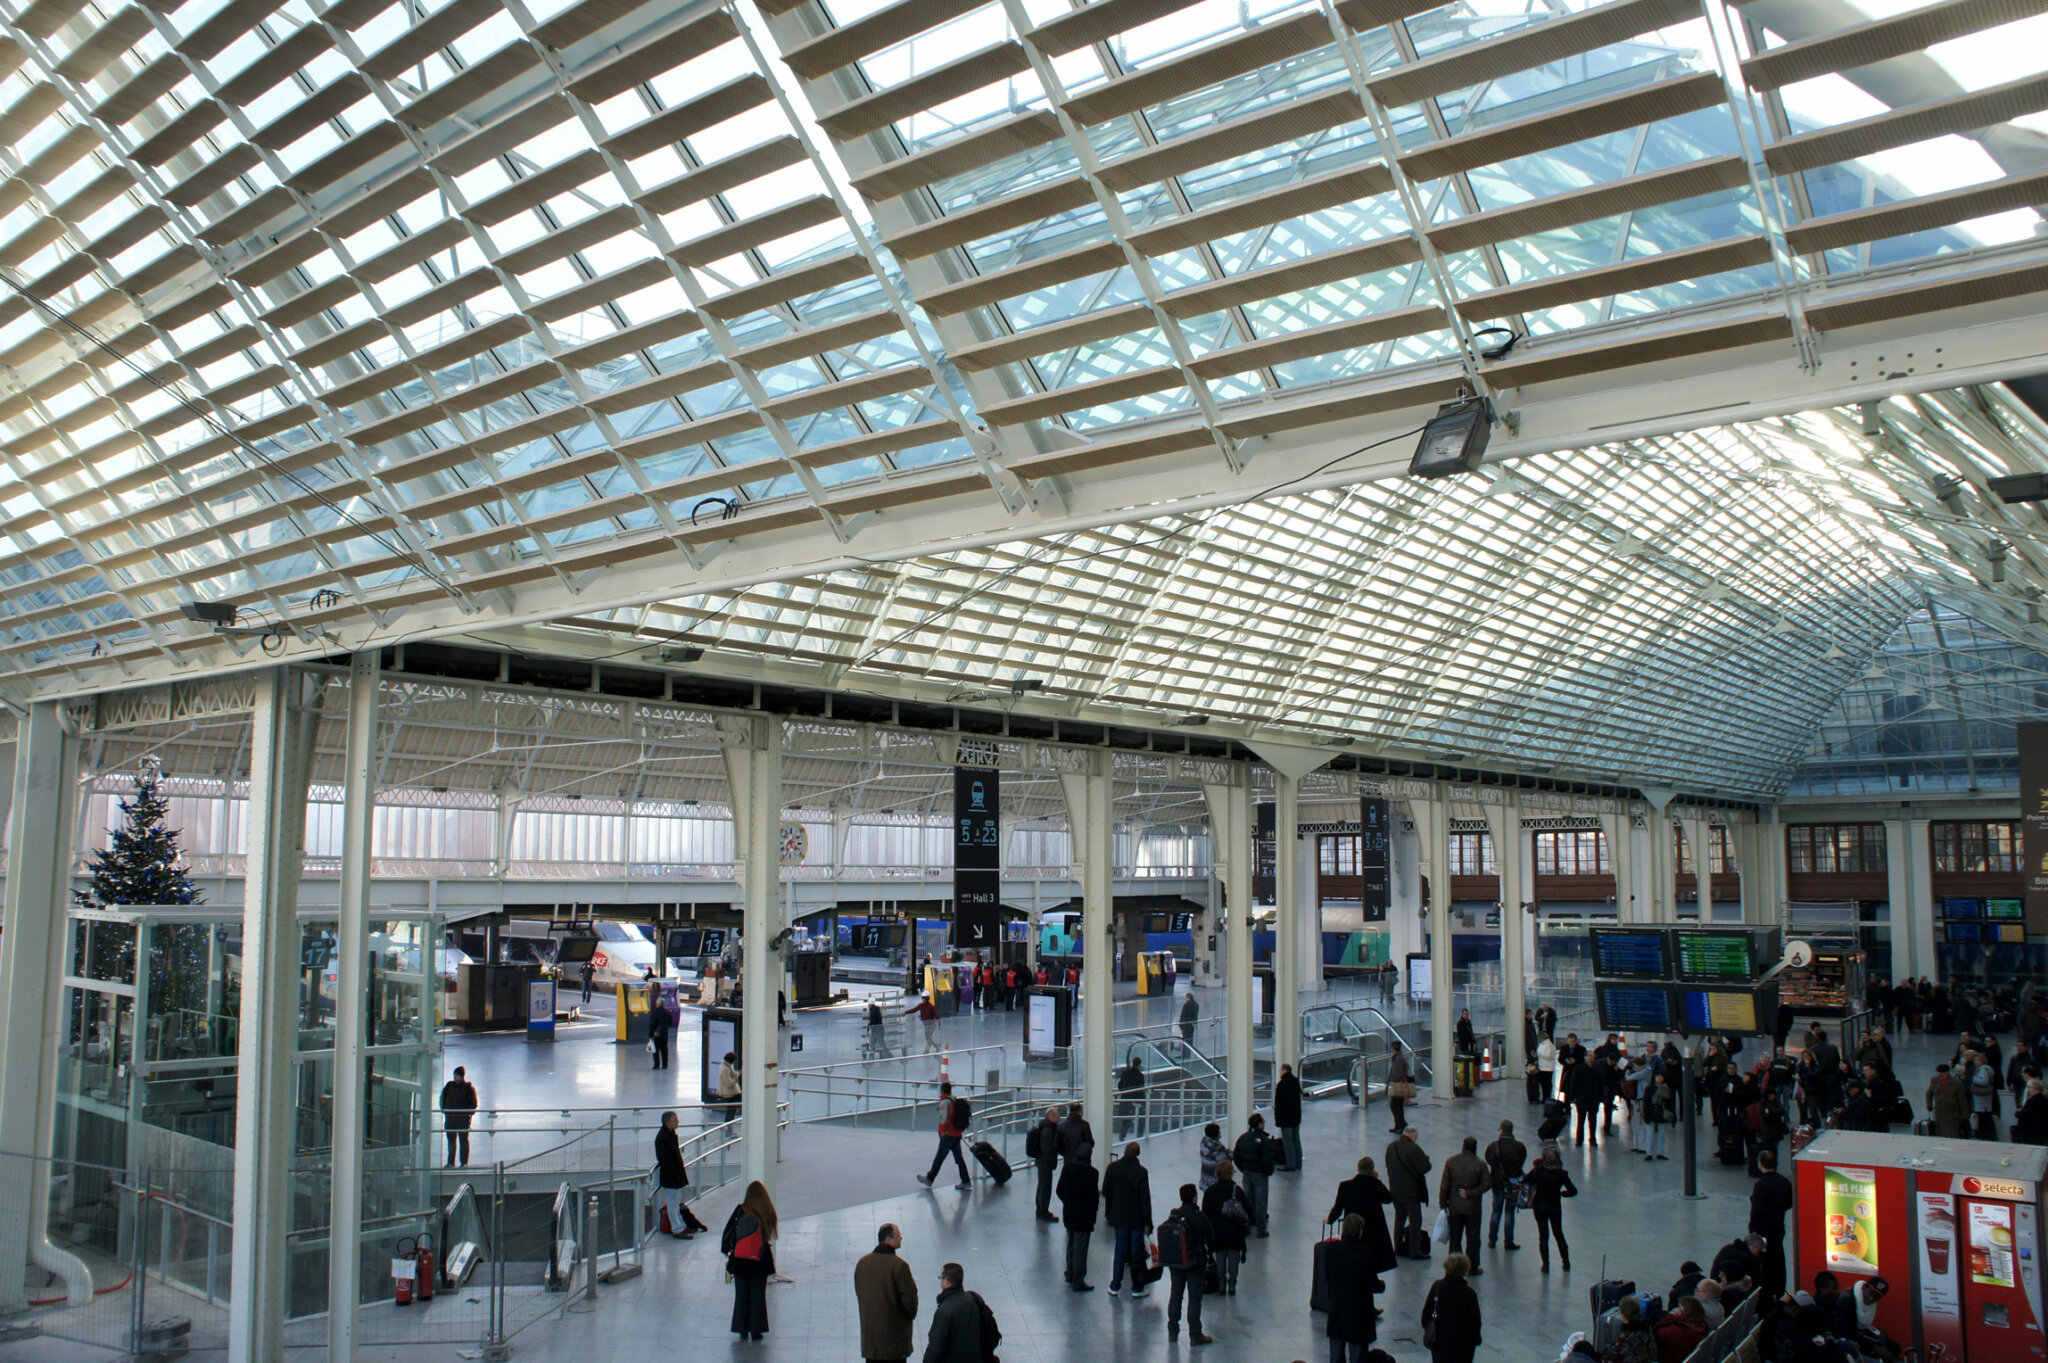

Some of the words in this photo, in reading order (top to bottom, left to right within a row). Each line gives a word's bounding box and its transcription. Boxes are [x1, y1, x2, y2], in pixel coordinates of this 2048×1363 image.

[962, 826, 970, 842] 5
[982, 826, 997, 843] 23
[973, 893, 988, 903] Hall
[989, 893, 994, 903] 3
[1176, 919, 1183, 929] 5
[867, 933, 879, 945] 11
[705, 938, 720, 953] 13
[305, 948, 327, 964] 17
[535, 999, 548, 1010] 15
[1983, 1183, 2025, 1196] selecta
